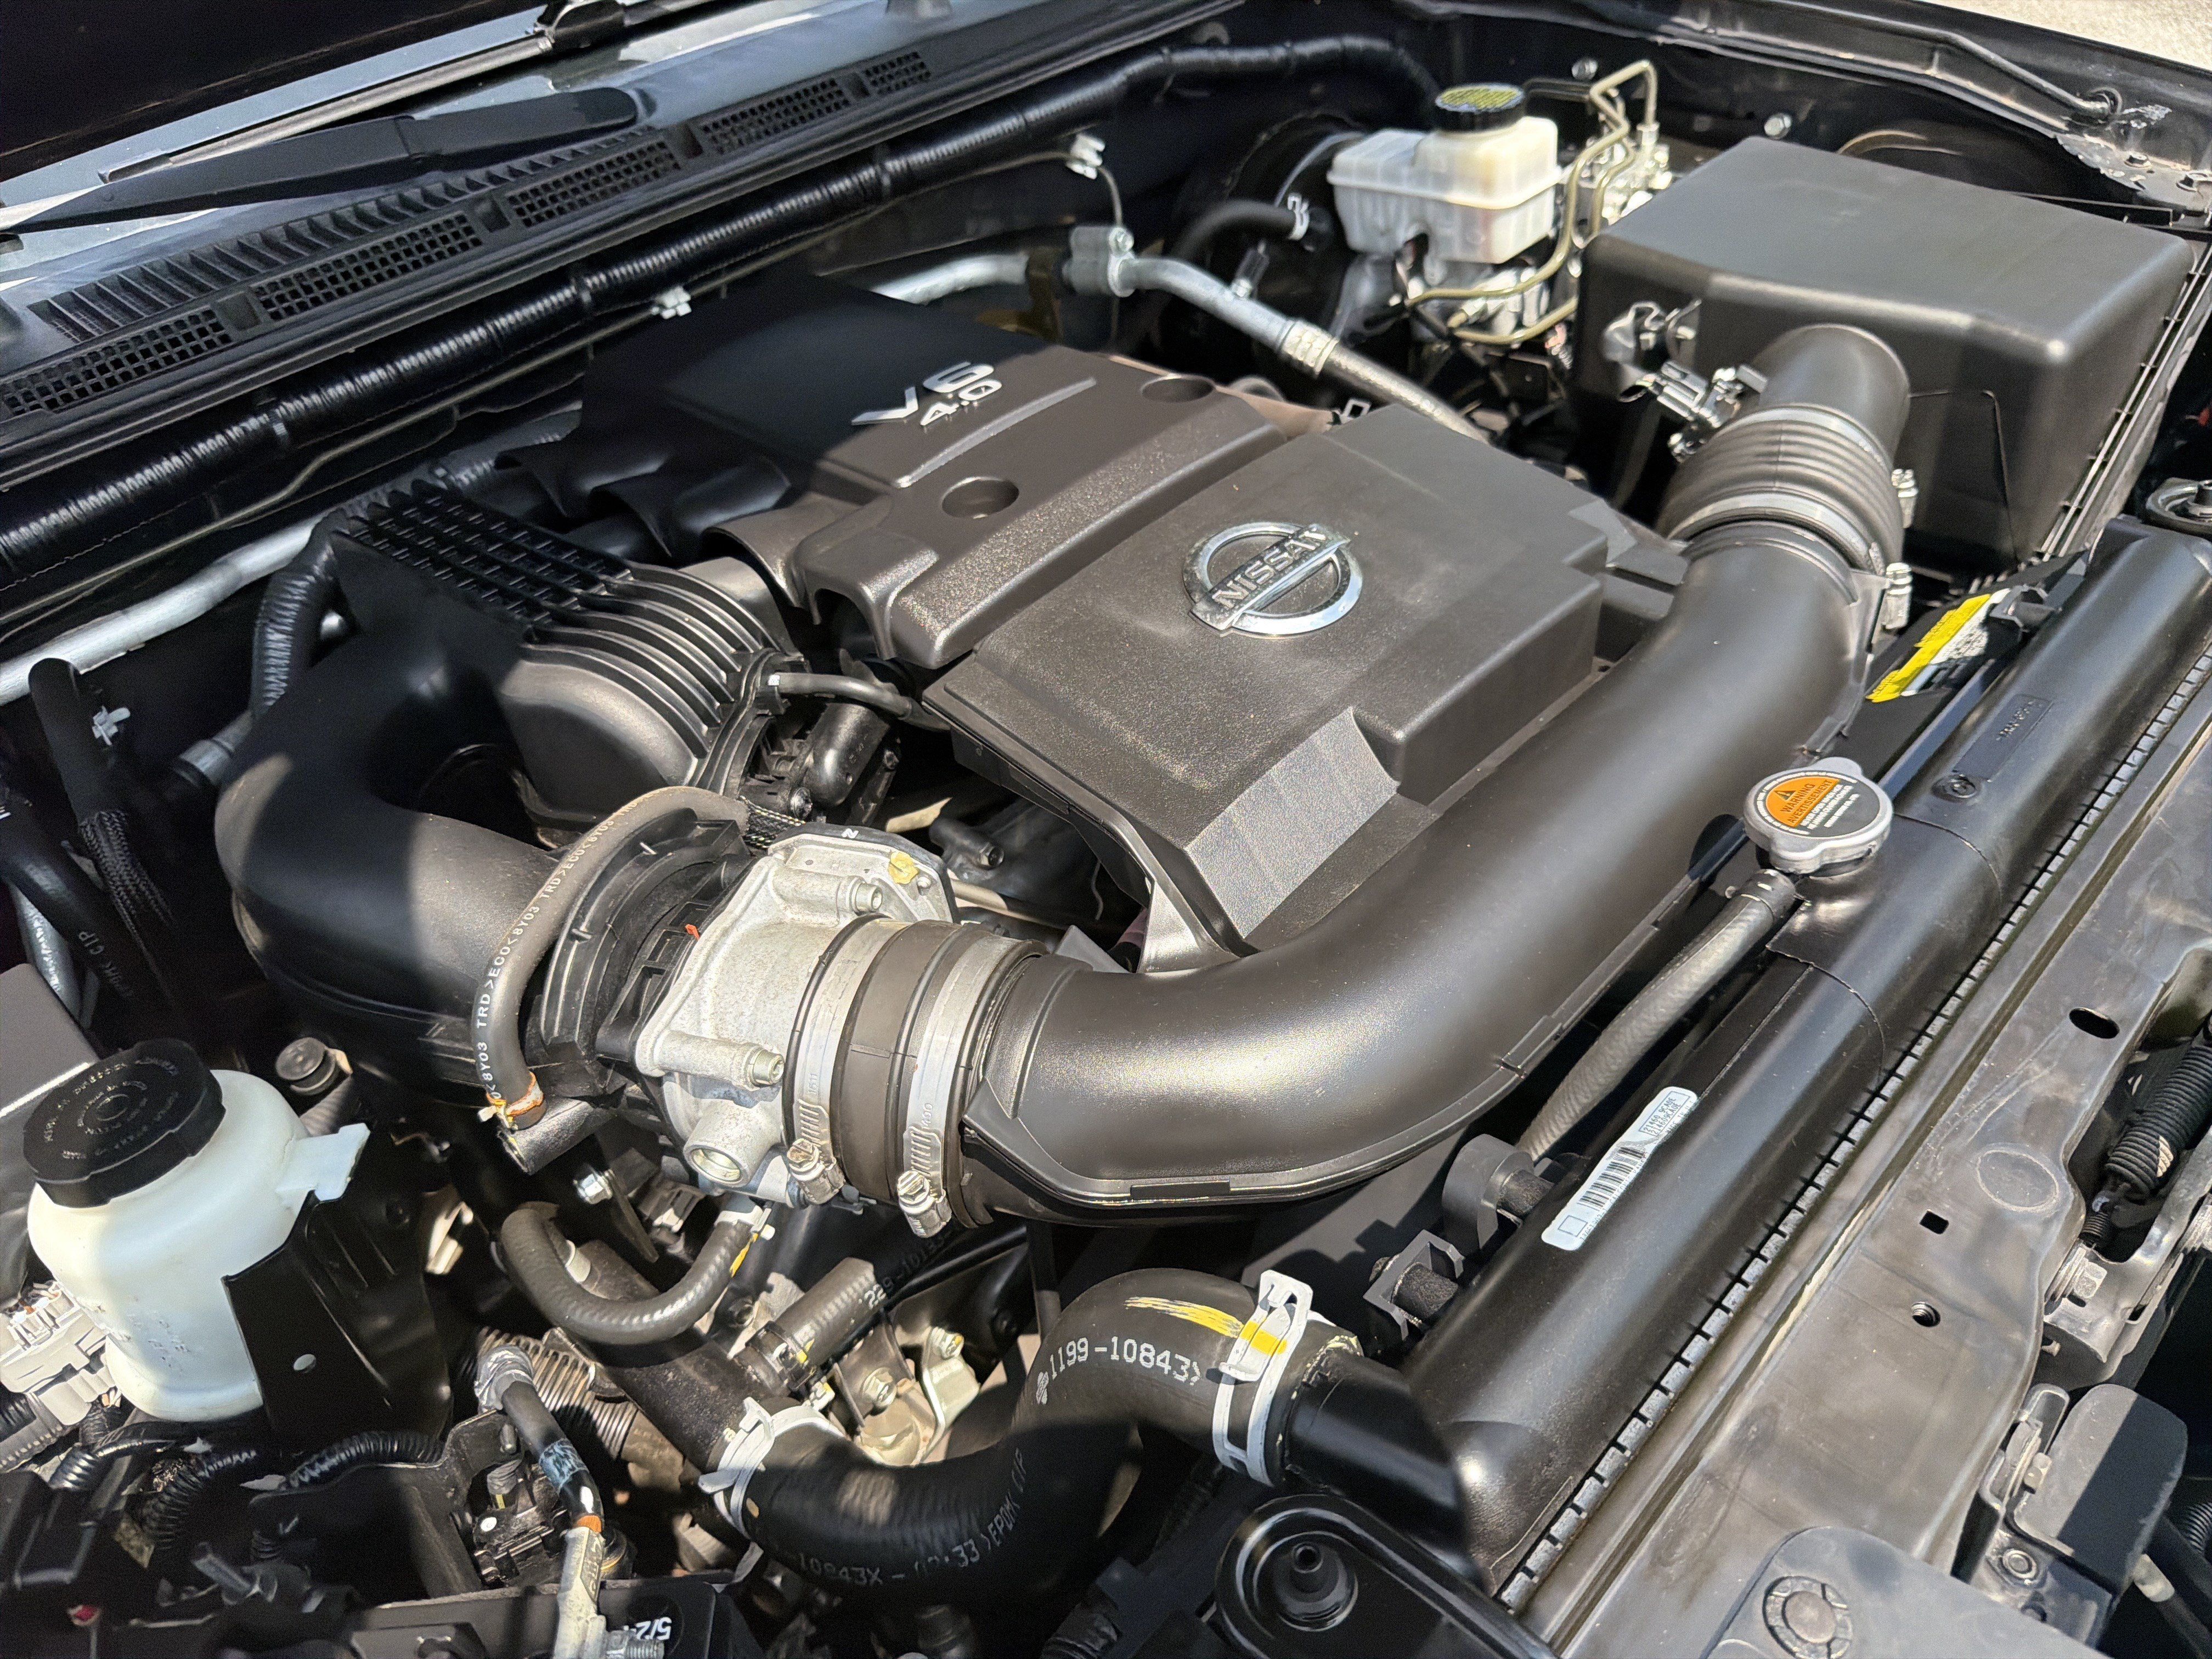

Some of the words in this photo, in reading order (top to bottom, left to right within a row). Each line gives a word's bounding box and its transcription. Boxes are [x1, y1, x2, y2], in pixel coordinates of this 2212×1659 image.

[851, 362, 994, 425] V6
[920, 379, 1002, 426] 4.0
[1211, 529, 1327, 608] NISSAN
[1779, 783, 1815, 813] WARNING
[1787, 780, 1831, 823] AVERTISSEMENT
